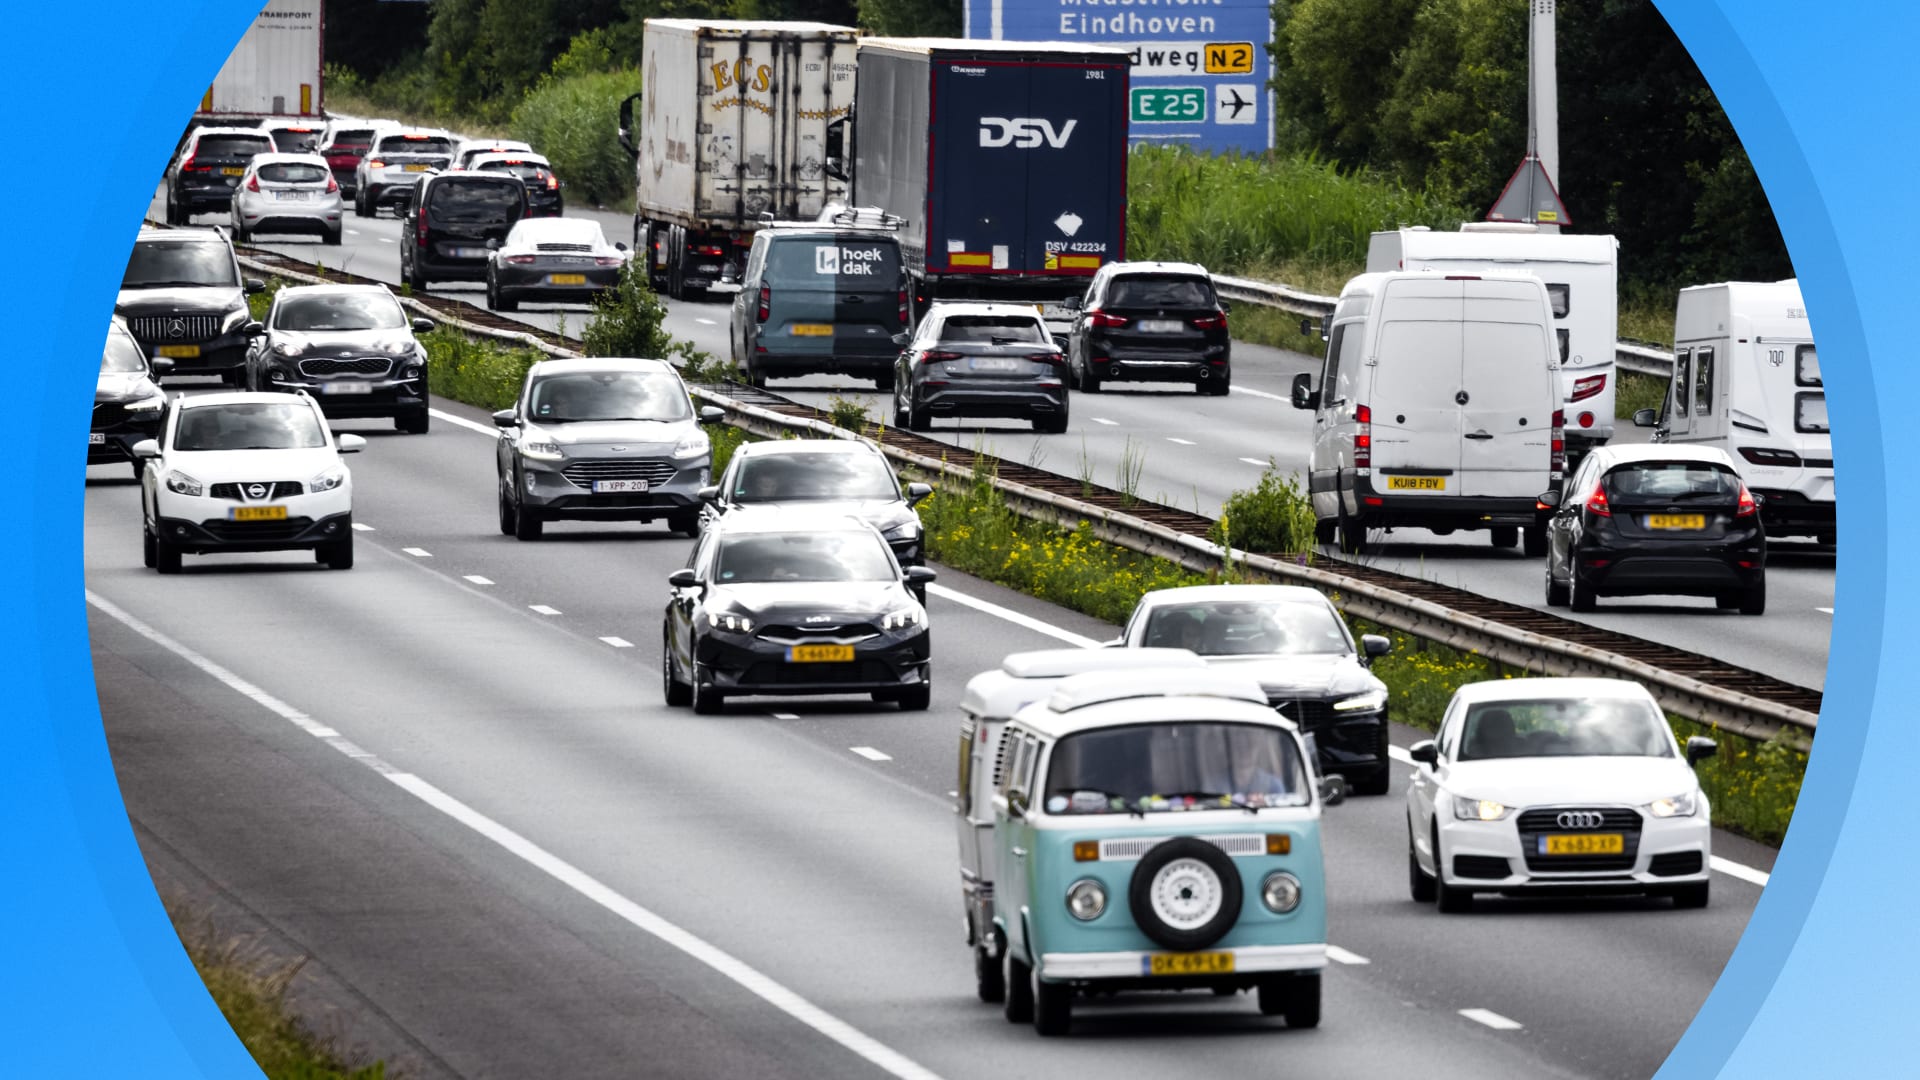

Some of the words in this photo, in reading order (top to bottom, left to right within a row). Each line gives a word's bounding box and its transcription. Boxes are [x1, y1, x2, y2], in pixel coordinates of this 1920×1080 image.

[1060, 12, 1215, 34] Eindhoven
[710, 56, 772, 92] ECS
[1086, 70, 1104, 79] 1981
[980, 117, 1078, 148] DSV
[1045, 241, 1068, 252] DSV
[1071, 242, 1106, 252] 422234
[843, 247, 882, 261] hoek
[843, 261, 873, 275] dak
[1394, 478, 1416, 488] KU18
